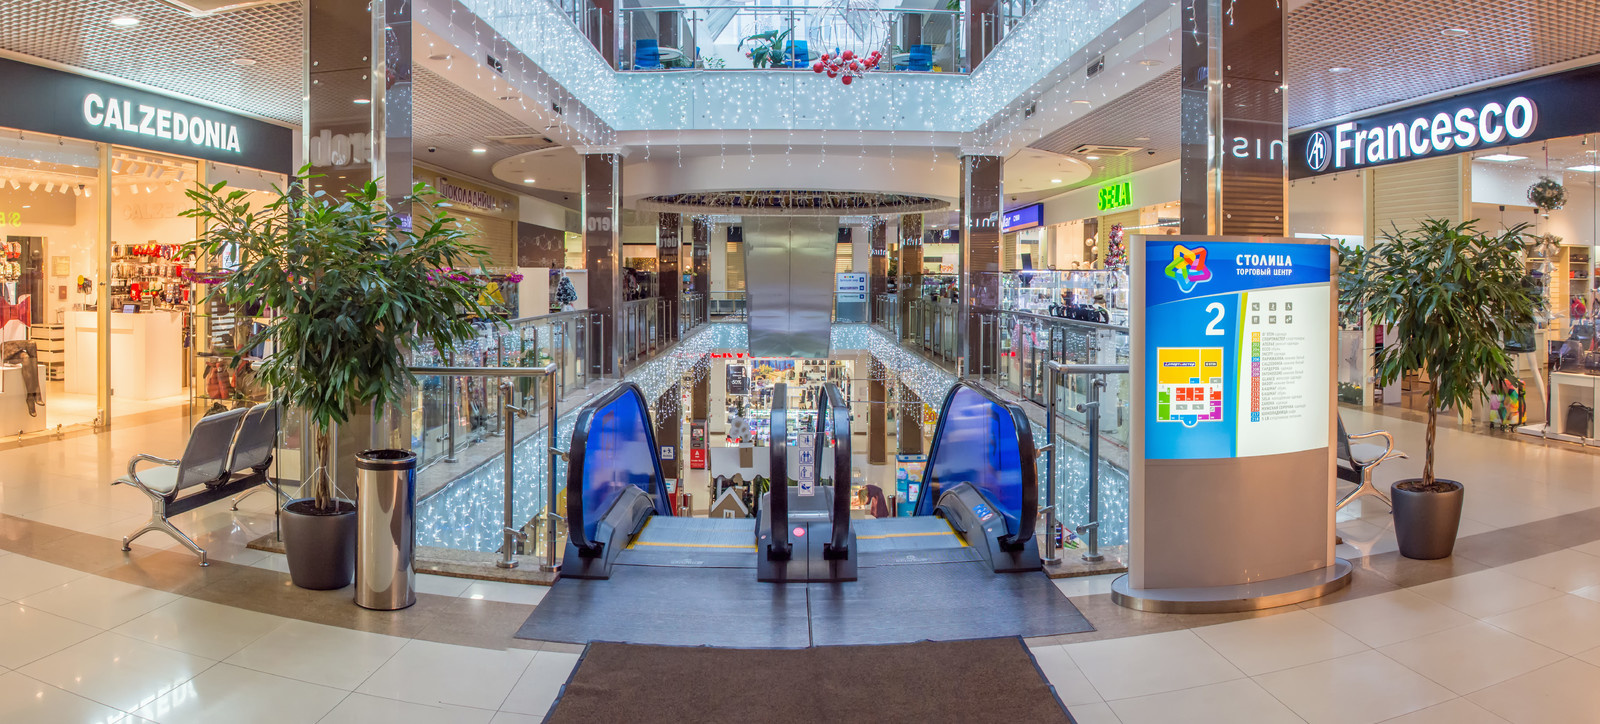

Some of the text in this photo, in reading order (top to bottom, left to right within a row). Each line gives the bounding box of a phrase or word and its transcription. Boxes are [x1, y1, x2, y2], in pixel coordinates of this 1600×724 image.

[84, 94, 241, 153] CALZEDONIA
[1335, 96, 1536, 168] Francesco
[1098, 182, 1133, 211] SELA
[1236, 254, 1293, 267] СТОЛИЦА
[1236, 267, 1293, 276] ТОРГОВЫЙ ЦЕНТР
[1205, 302, 1225, 336] 2
